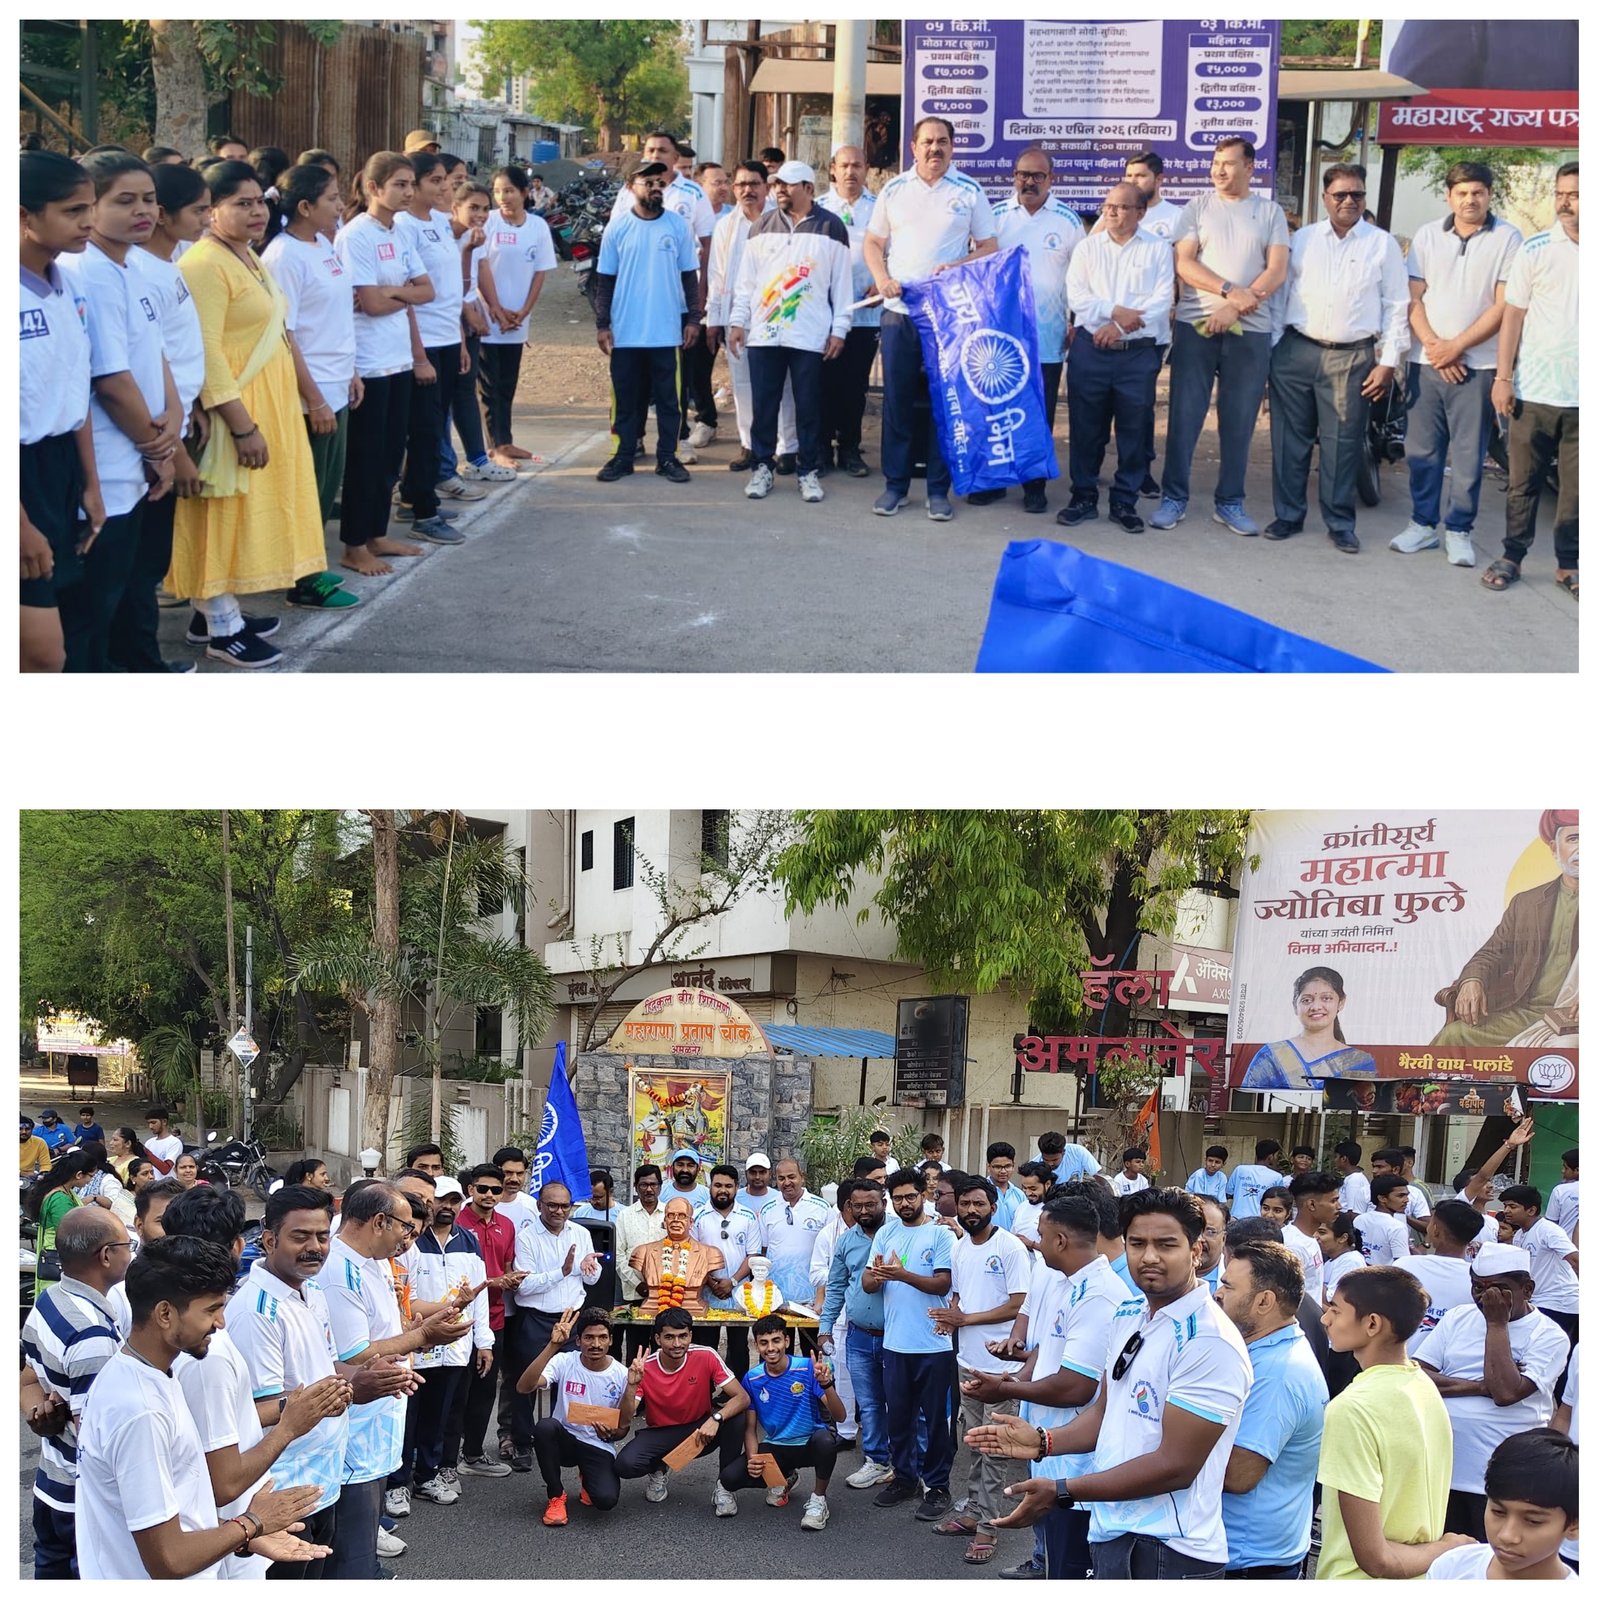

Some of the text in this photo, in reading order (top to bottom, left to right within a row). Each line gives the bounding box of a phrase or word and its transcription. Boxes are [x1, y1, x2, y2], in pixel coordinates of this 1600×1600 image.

[1208, 35, 1252, 46] महिला गट
[1009, 122, 1172, 136] दिनांक: १२ एप्रिल २०२६ (रविवार)
[1391, 106, 1486, 133] महाराष्ट्र
[1488, 107, 1546, 128] राज्य
[1060, 140, 1091, 150] सकाळी
[20, 311, 46, 332] 42
[1321, 818, 1437, 851] क्रांतीसूर्य
[1300, 851, 1450, 886] महात्मा
[1253, 881, 1468, 924] ज्योतिबा फुले
[1300, 924, 1394, 939] यांच्या जयंती निमित्त
[1287, 941, 1322, 955] विनम्र
[671, 963, 716, 991] आनंद
[677, 989, 693, 1004] वीर
[624, 1016, 752, 1042] महाराणा प्रताप चौक
[1398, 1052, 1434, 1071] भैरवी
[570, 1383, 583, 1393] 116
